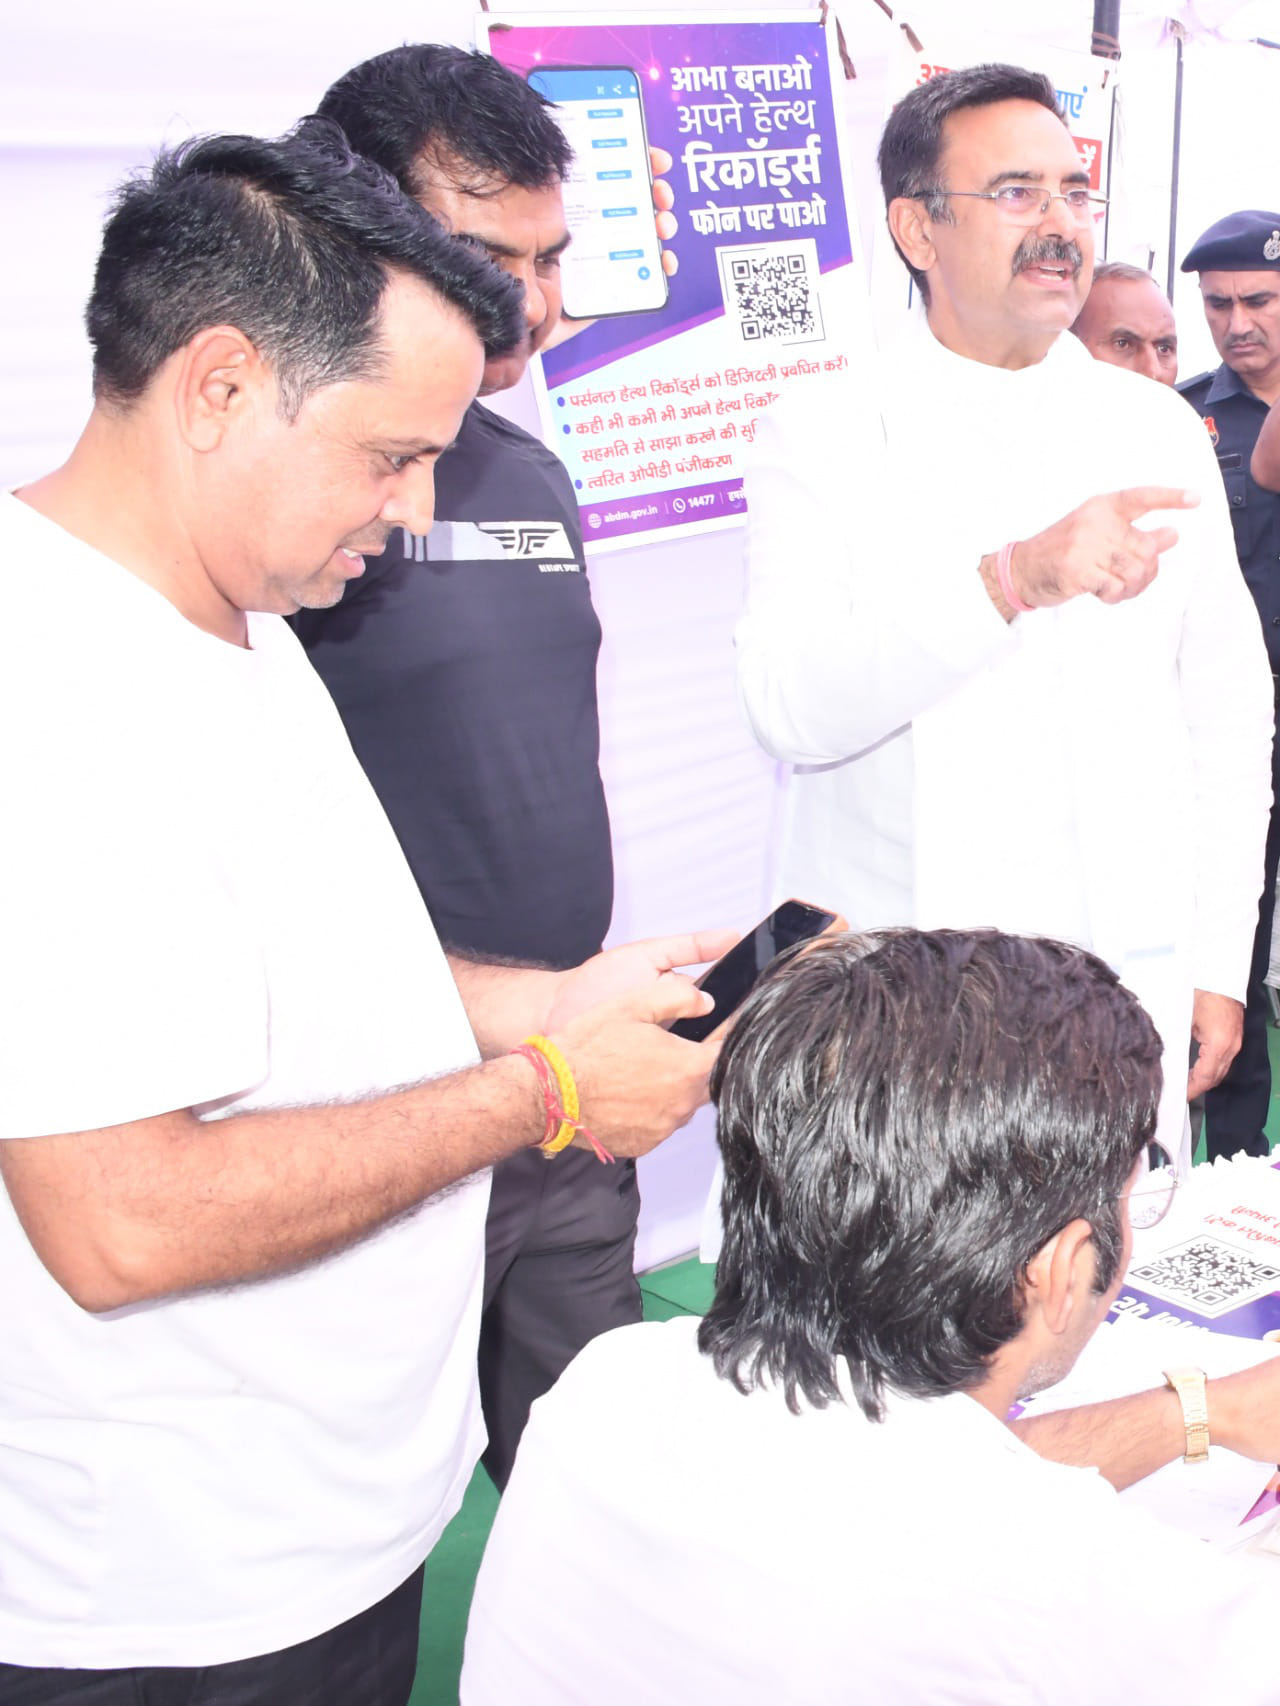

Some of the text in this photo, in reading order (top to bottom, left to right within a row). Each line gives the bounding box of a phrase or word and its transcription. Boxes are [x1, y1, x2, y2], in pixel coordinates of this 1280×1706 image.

[670, 55, 813, 93] आभा बनाओ
[677, 93, 816, 135] अपने हेल्थ
[681, 134, 822, 198] रिकॉर्ड्स
[689, 192, 827, 235] फोन पर पाओ
[620, 383, 647, 402] हेल्थ
[704, 371, 722, 389] को
[724, 364, 777, 386] डिजिटली
[608, 412, 625, 430] भी
[628, 408, 657, 427] कभी
[661, 404, 677, 422] भी
[680, 400, 712, 421] अपने
[716, 396, 742, 415] हेल्थ
[582, 439, 629, 464] सहमति
[633, 438, 646, 455] से
[649, 435, 682, 453] साझा
[686, 426, 716, 447] करने
[720, 423, 737, 440] की
[587, 454, 733, 490] त्वरित ओपीडी पंजीकरण
[604, 505, 658, 522] abdm.gov.in
[688, 493, 716, 509] 14477
